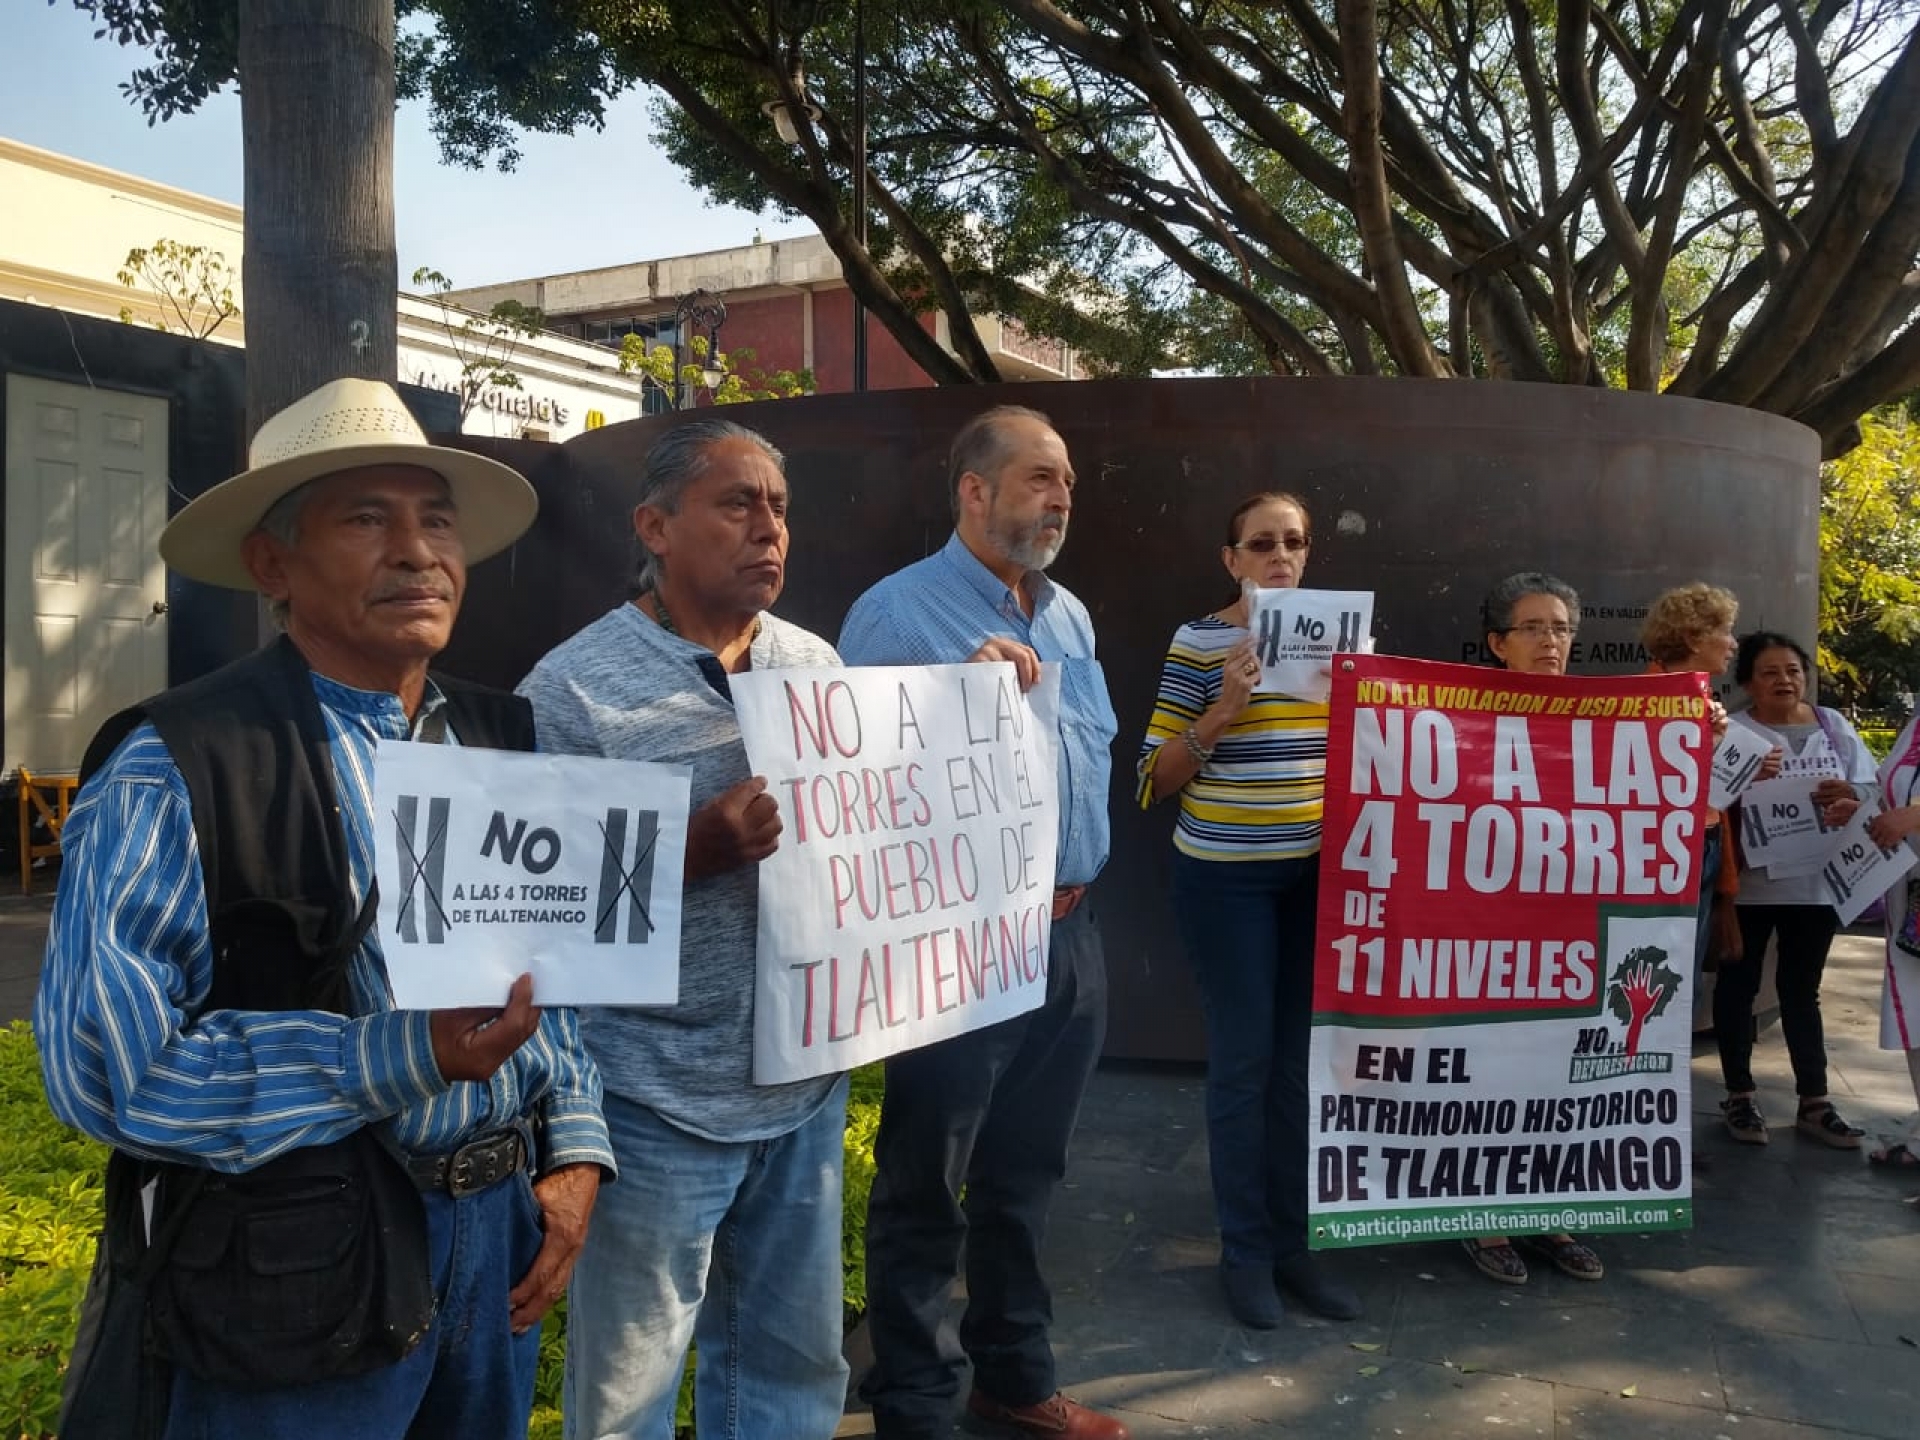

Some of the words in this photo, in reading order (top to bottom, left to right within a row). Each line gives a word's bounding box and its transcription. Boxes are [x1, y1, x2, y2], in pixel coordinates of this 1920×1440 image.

[1294, 614, 1325, 641] NO
[1589, 642, 1653, 663] ARMA
[1357, 680, 1387, 704] NO
[1391, 682, 1404, 705] A
[1406, 684, 1429, 707] LA
[1434, 685, 1548, 713] VIOLACION
[1545, 697, 1576, 715] DE
[1576, 696, 1617, 717] USO
[1618, 696, 1645, 718] DE
[1644, 695, 1705, 719] SUELO
[784, 679, 862, 761] NO
[898, 680, 925, 750] A
[1350, 708, 1459, 799] NO
[1493, 716, 1541, 802] A
[1571, 719, 1702, 807] LAS
[1723, 744, 1740, 766] NO
[780, 762, 932, 844] TORRES
[946, 753, 1002, 820] EN
[1014, 750, 1043, 810] EL
[1772, 803, 1799, 819] NO
[480, 810, 561, 875] NO
[1341, 801, 1398, 888] 4
[1418, 803, 1695, 895] TORRES
[1840, 843, 1864, 866] NO
[453, 883, 465, 901] A
[470, 884, 500, 901] LAS
[504, 886, 514, 901] 4
[519, 884, 588, 902] TORRES
[830, 833, 979, 929] PUEBLO
[1000, 821, 1039, 896] DE
[452, 909, 471, 923] DE
[474, 908, 586, 923] TLALTENANGO
[1343, 890, 1386, 928] DE
[790, 902, 1049, 1047] TLALTENANGO
[1331, 934, 1385, 996] 11
[1400, 938, 1597, 1000] NIVELES
[1573, 1026, 1608, 1054] NO
[1355, 1044, 1415, 1082] EN
[1426, 1048, 1471, 1083] EL
[1320, 1094, 1517, 1136] PATRIMONIO
[1522, 1088, 1678, 1134] HISTORICO
[1318, 1145, 1369, 1203] DE
[1381, 1136, 1683, 1199] TLALTENANGO
[1330, 1206, 1668, 1241] v.participantestlaltenango@gmail.com
